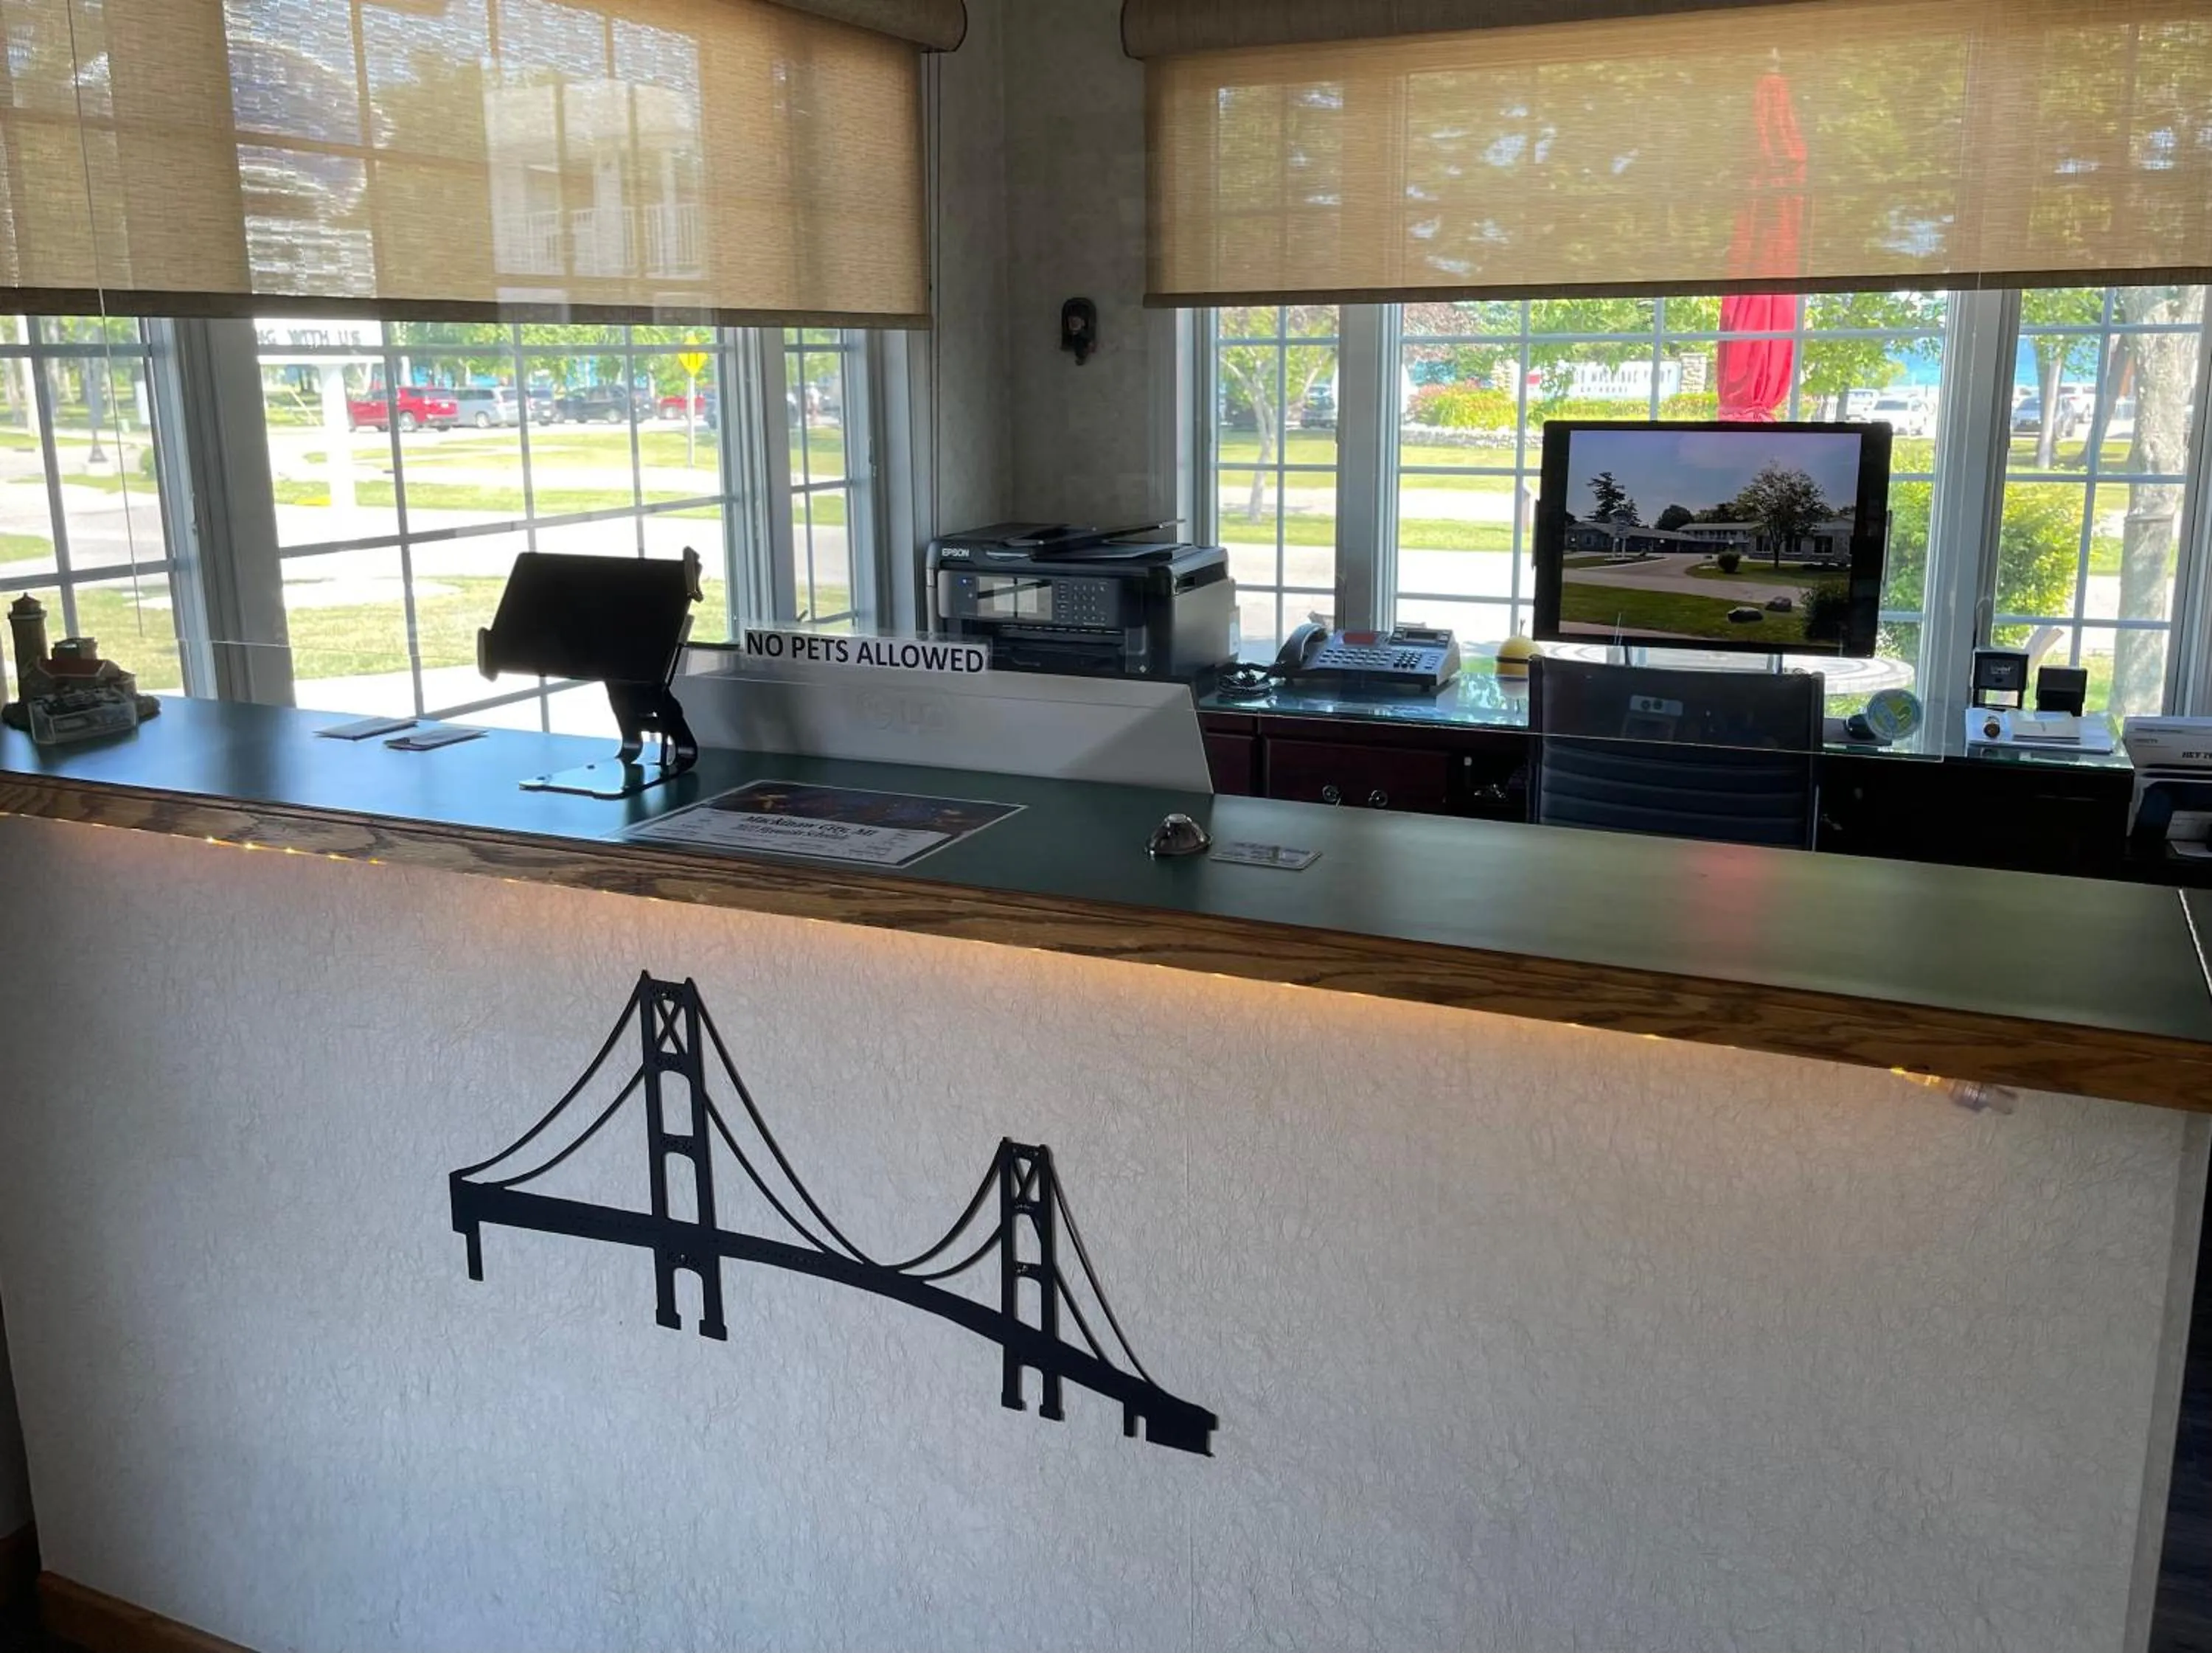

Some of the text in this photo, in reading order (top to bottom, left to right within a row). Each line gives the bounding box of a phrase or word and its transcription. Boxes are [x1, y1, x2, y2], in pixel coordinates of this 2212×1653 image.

[942, 548, 970, 557] EPSON
[746, 632, 984, 673] NO PETS ALLOWED
